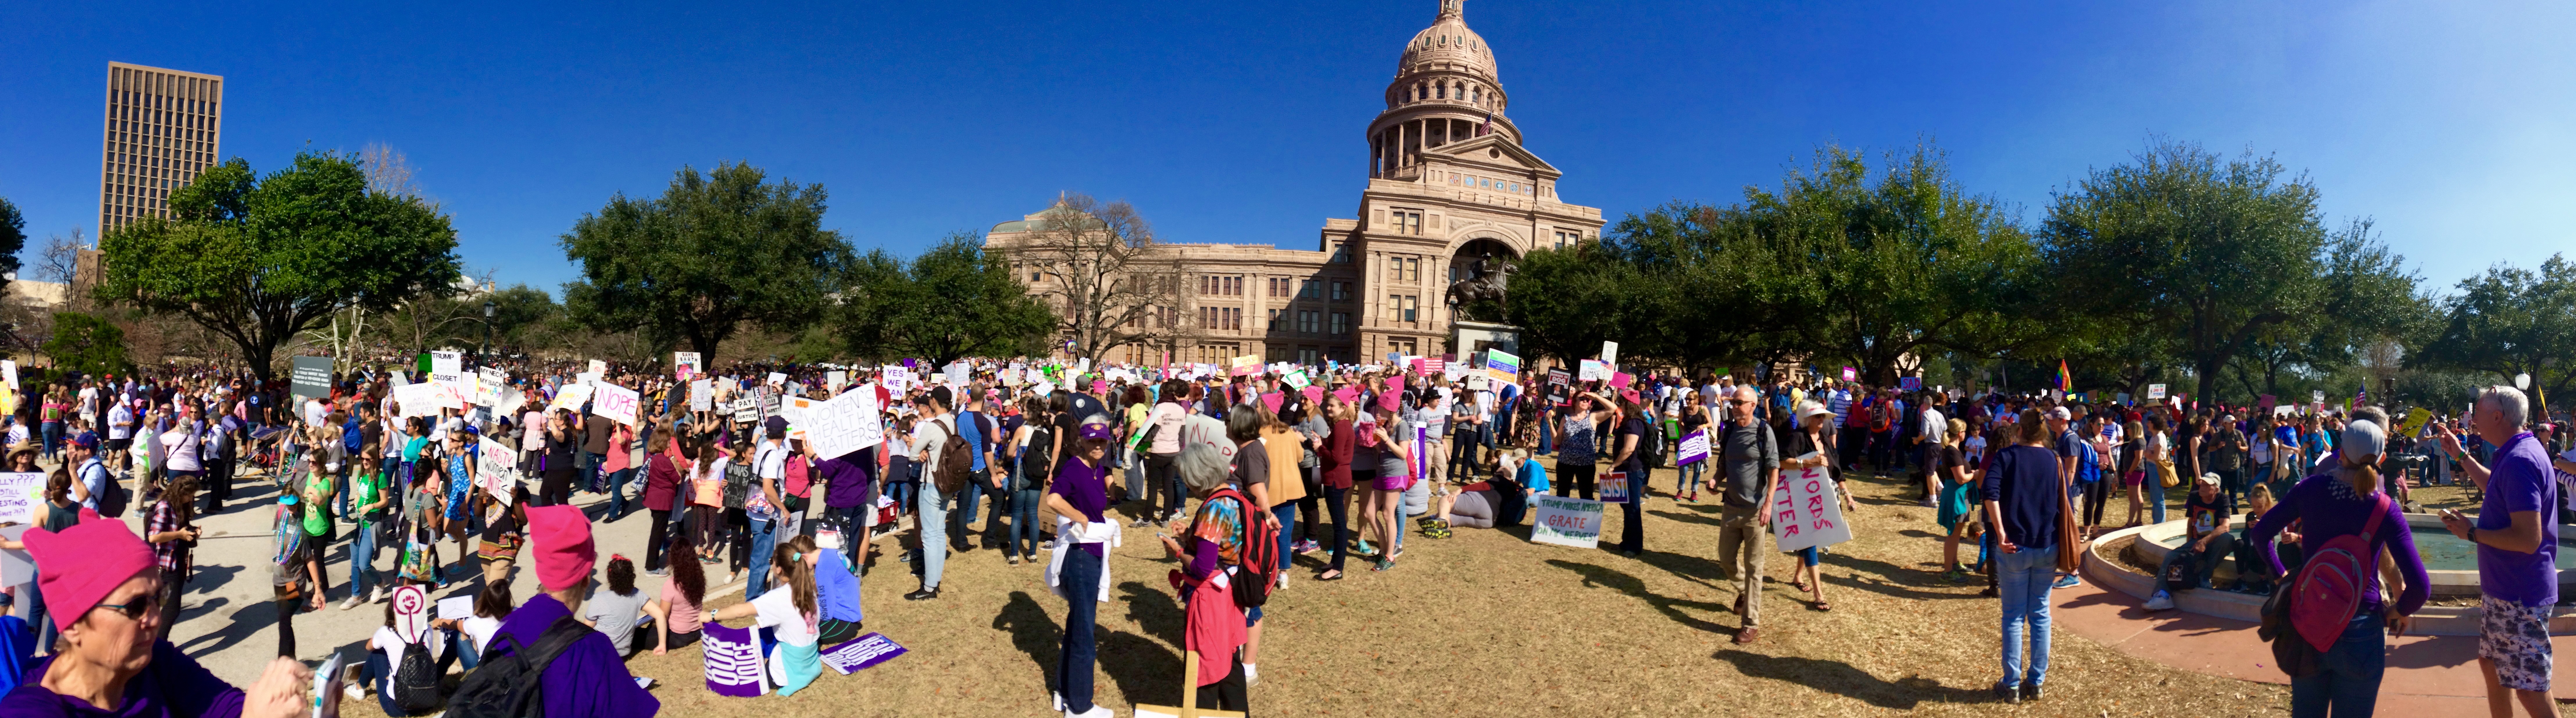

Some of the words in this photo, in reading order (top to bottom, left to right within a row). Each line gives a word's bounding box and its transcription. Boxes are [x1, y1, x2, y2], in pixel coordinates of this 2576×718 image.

[490, 370, 503, 378] NECK
[887, 369, 904, 377] YES
[1903, 378, 1920, 389] SAD
[488, 380, 502, 388] BACK
[482, 399, 495, 407] WILL
[597, 387, 637, 417] NOPE
[739, 399, 751, 407] PAY
[754, 387, 765, 427] EQUITY
[804, 389, 875, 428] WOMEN'S
[484, 414, 499, 424] BACK
[812, 410, 866, 441] HEALTH
[814, 414, 882, 456] MATTERS!
[1697, 435, 1707, 454] VOICE
[487, 445, 513, 468] NASTY
[1678, 440, 1688, 461] HEAR
[1687, 435, 1700, 457] OUR
[483, 471, 502, 497] UNITE
[1600, 478, 1625, 497] RESIST
[1541, 499, 1562, 509] TRUMP
[1562, 501, 1580, 511] MAKES
[1581, 502, 1603, 513] AMERICA
[1775, 468, 1799, 538] ATTER
[1800, 466, 1833, 530] WORDS
[1548, 515, 1587, 529] GRATE
[1537, 527, 1548, 535] ON
[1550, 528, 1560, 537] MY
[1564, 531, 1597, 542] NERVES!
[701, 629, 713, 681] HEAR
[838, 643, 878, 665] OUR
[859, 636, 896, 655] HEAR
[709, 637, 739, 686] OUR
[732, 640, 760, 685] VOICE
[825, 651, 857, 667] VOICE
